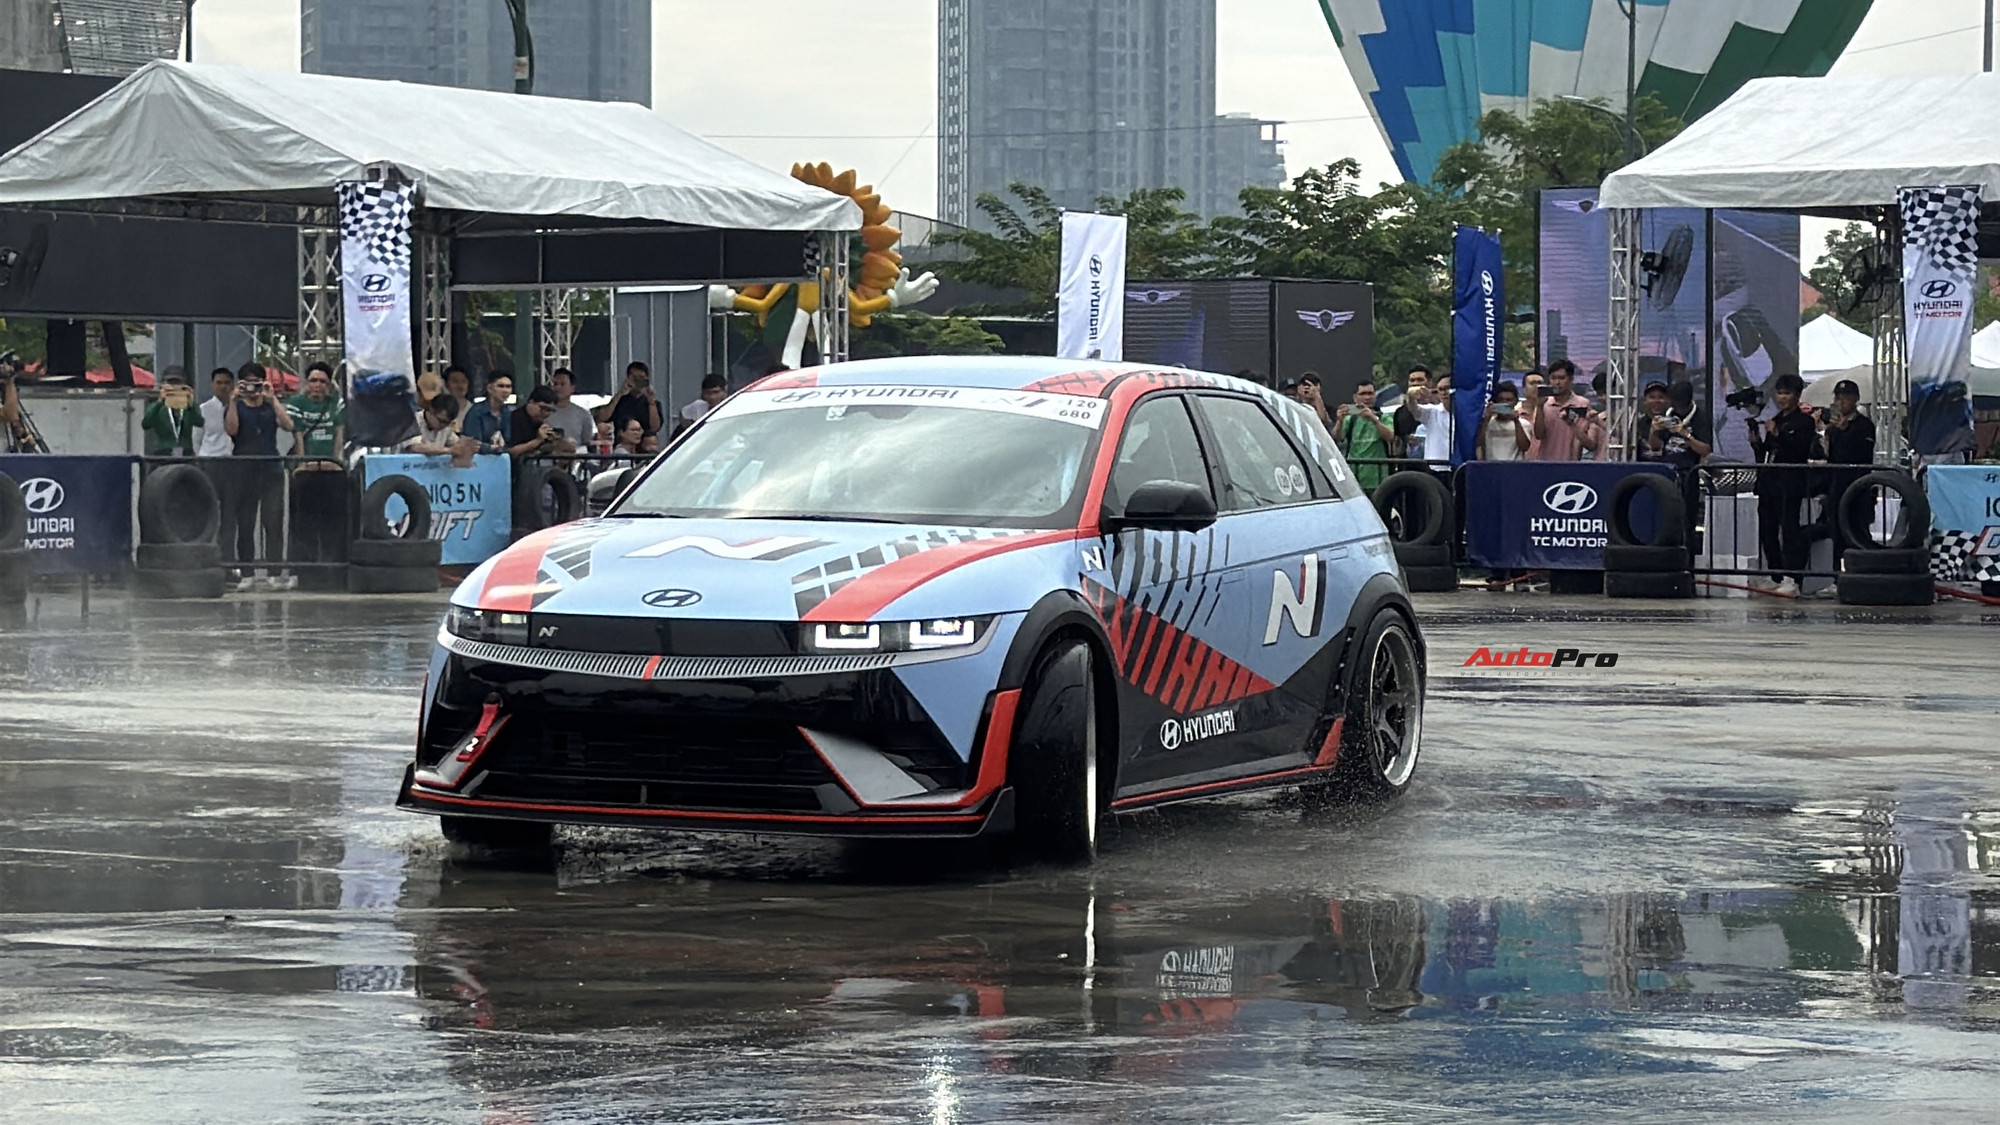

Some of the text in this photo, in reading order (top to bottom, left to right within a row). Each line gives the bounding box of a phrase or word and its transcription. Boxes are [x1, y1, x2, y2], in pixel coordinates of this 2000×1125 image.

[1088, 281, 1100, 340] HYUNDAI
[1913, 300, 1963, 311] HYUNDAI
[1484, 298, 1496, 362] HYUNDAI
[826, 388, 959, 399] HYUNDAI
[1067, 399, 1097, 409] 120
[1059, 410, 1091, 420] 680
[457, 483, 466, 503] 5
[469, 483, 481, 503] N
[27, 517, 75, 534] UNDAI
[1530, 518, 1608, 533] HYUNDAI
[1552, 537, 1608, 548] MOTOR
[1183, 710, 1237, 743] HYUNDAI
